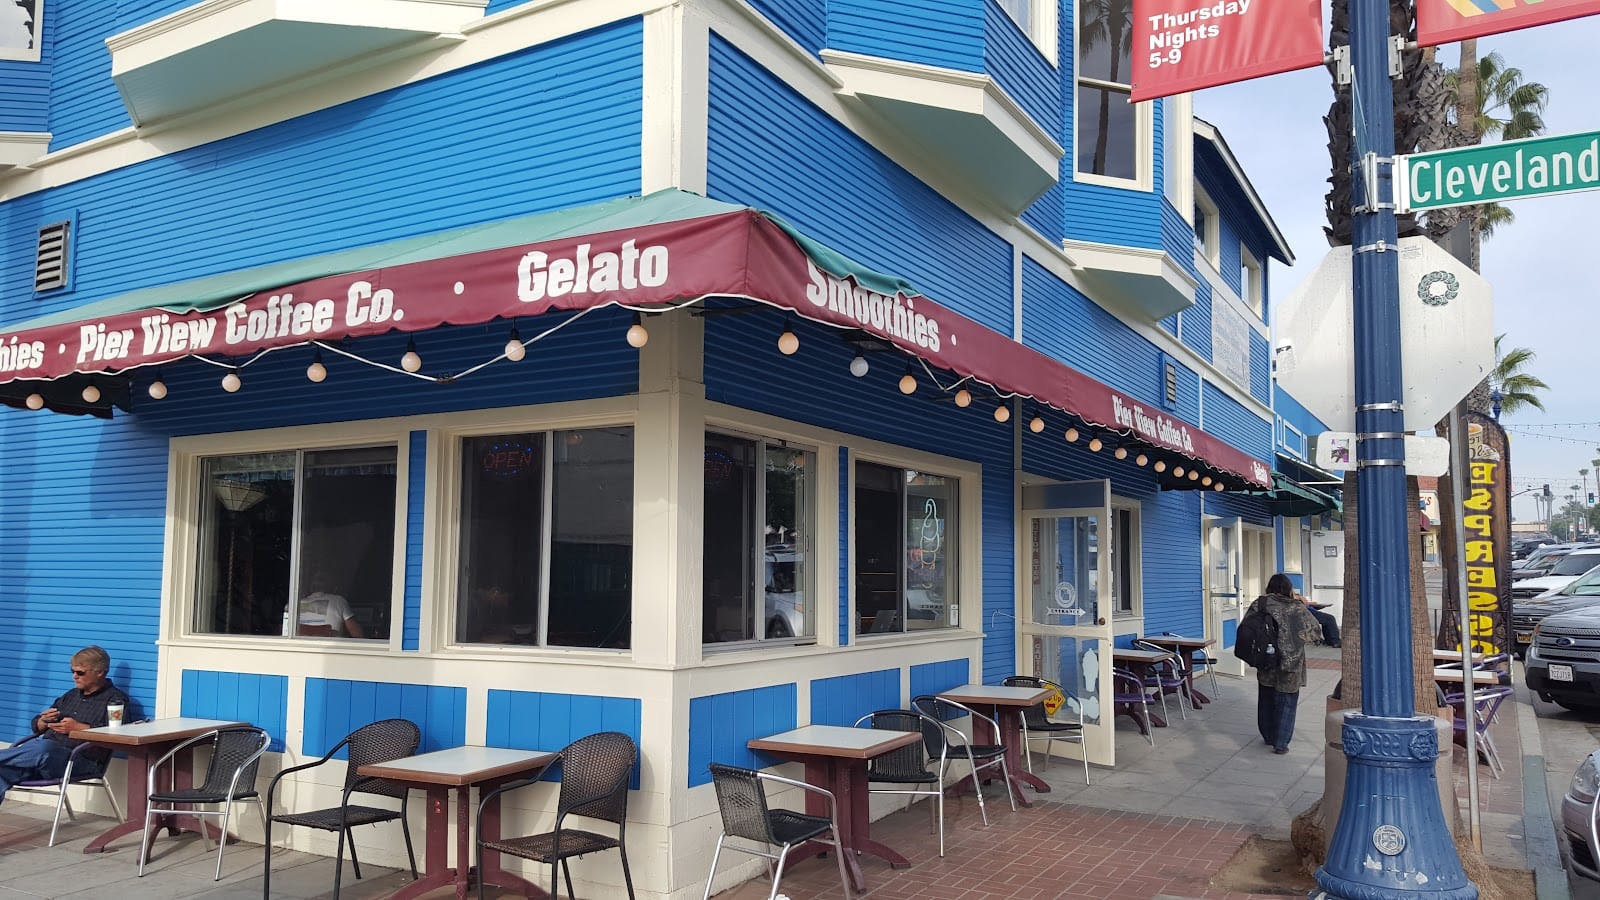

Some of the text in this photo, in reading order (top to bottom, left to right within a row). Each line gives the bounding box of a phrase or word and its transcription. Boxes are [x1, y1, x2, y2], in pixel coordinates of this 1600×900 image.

[1149, 0, 1250, 31] Thursday
[1150, 24, 1220, 49] Nights
[1149, 49, 1182, 68] 5-9
[1410, 139, 1599, 204] Cleveland
[518, 239, 669, 303] Gelato
[75, 281, 404, 364] Pier View Coffee Co.
[806, 256, 941, 353] Smoothies
[1112, 394, 1195, 453] Pier View Coffee Co.
[483, 450, 532, 469] OPEN
